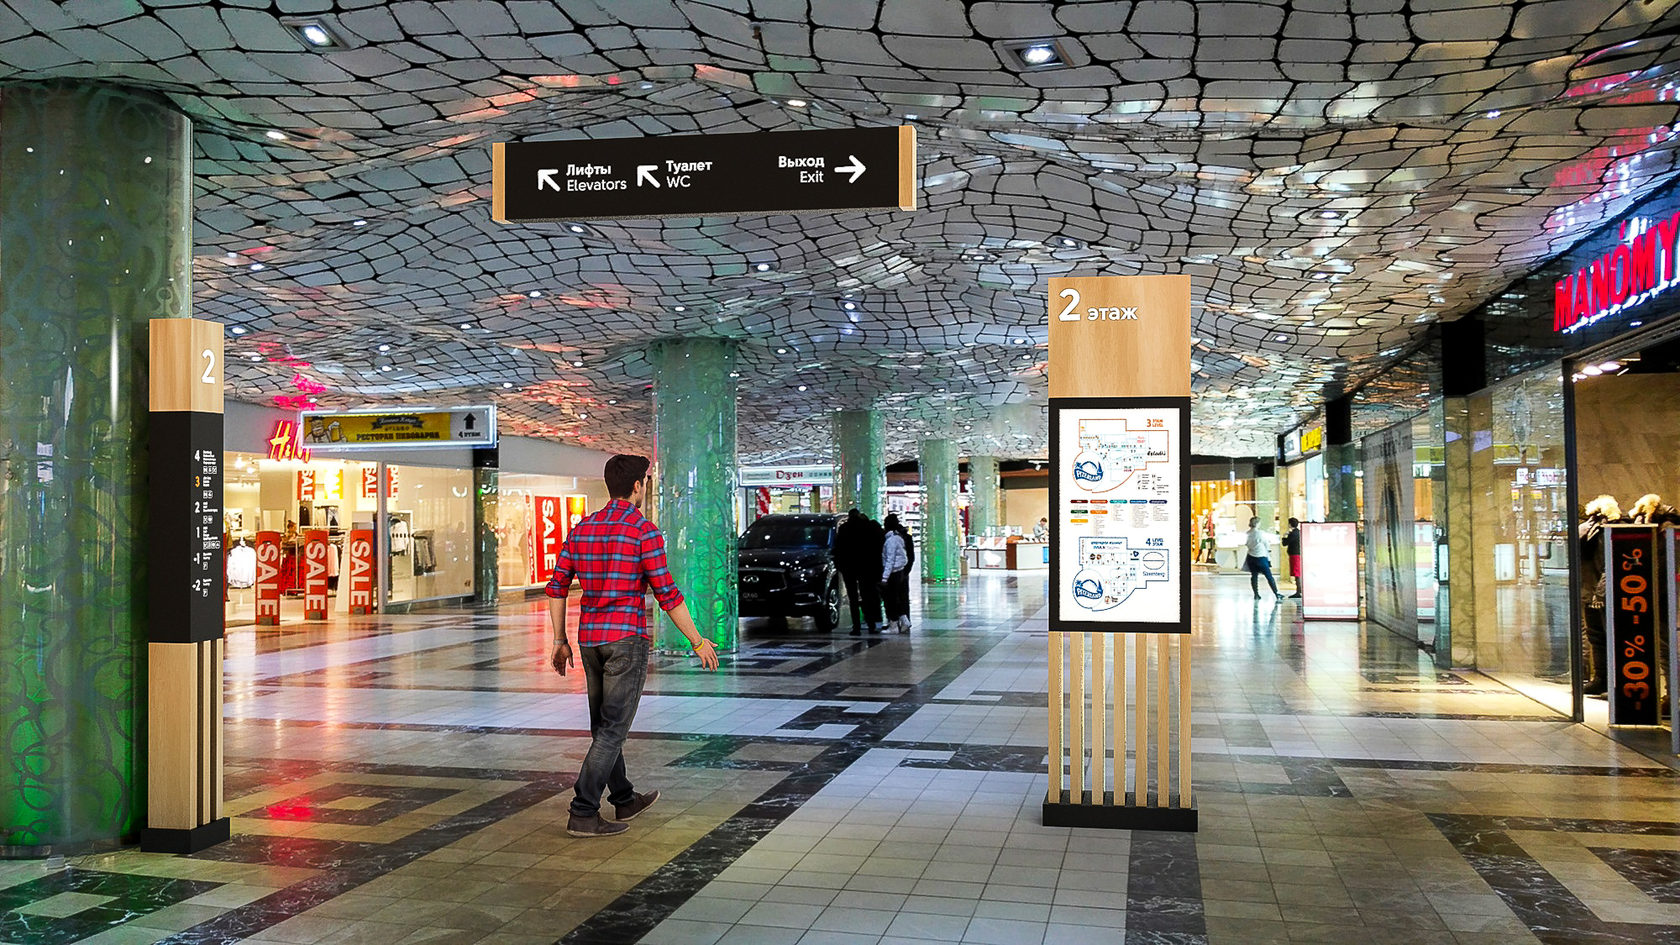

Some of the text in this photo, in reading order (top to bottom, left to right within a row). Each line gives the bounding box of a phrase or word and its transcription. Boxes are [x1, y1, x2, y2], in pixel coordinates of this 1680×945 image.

[666, 160, 713, 174] Туалет
[778, 155, 825, 168] Выход
[566, 163, 612, 177] Лифты
[666, 176, 691, 188] WC
[800, 171, 824, 183] Exit
[567, 179, 627, 192] Elevators
[1058, 288, 1138, 321] 2 этаж
[201, 348, 216, 385] 2
[1146, 418, 1152, 428] 3
[194, 450, 201, 461] 4
[195, 475, 201, 488] 3
[194, 501, 201, 514] 2
[195, 526, 200, 538] 1
[541, 499, 557, 571] SALE
[257, 543, 279, 616] SALE
[305, 541, 326, 611] SALE
[350, 540, 370, 606] SALE
[1620, 548, 1649, 710] -30% -50%
